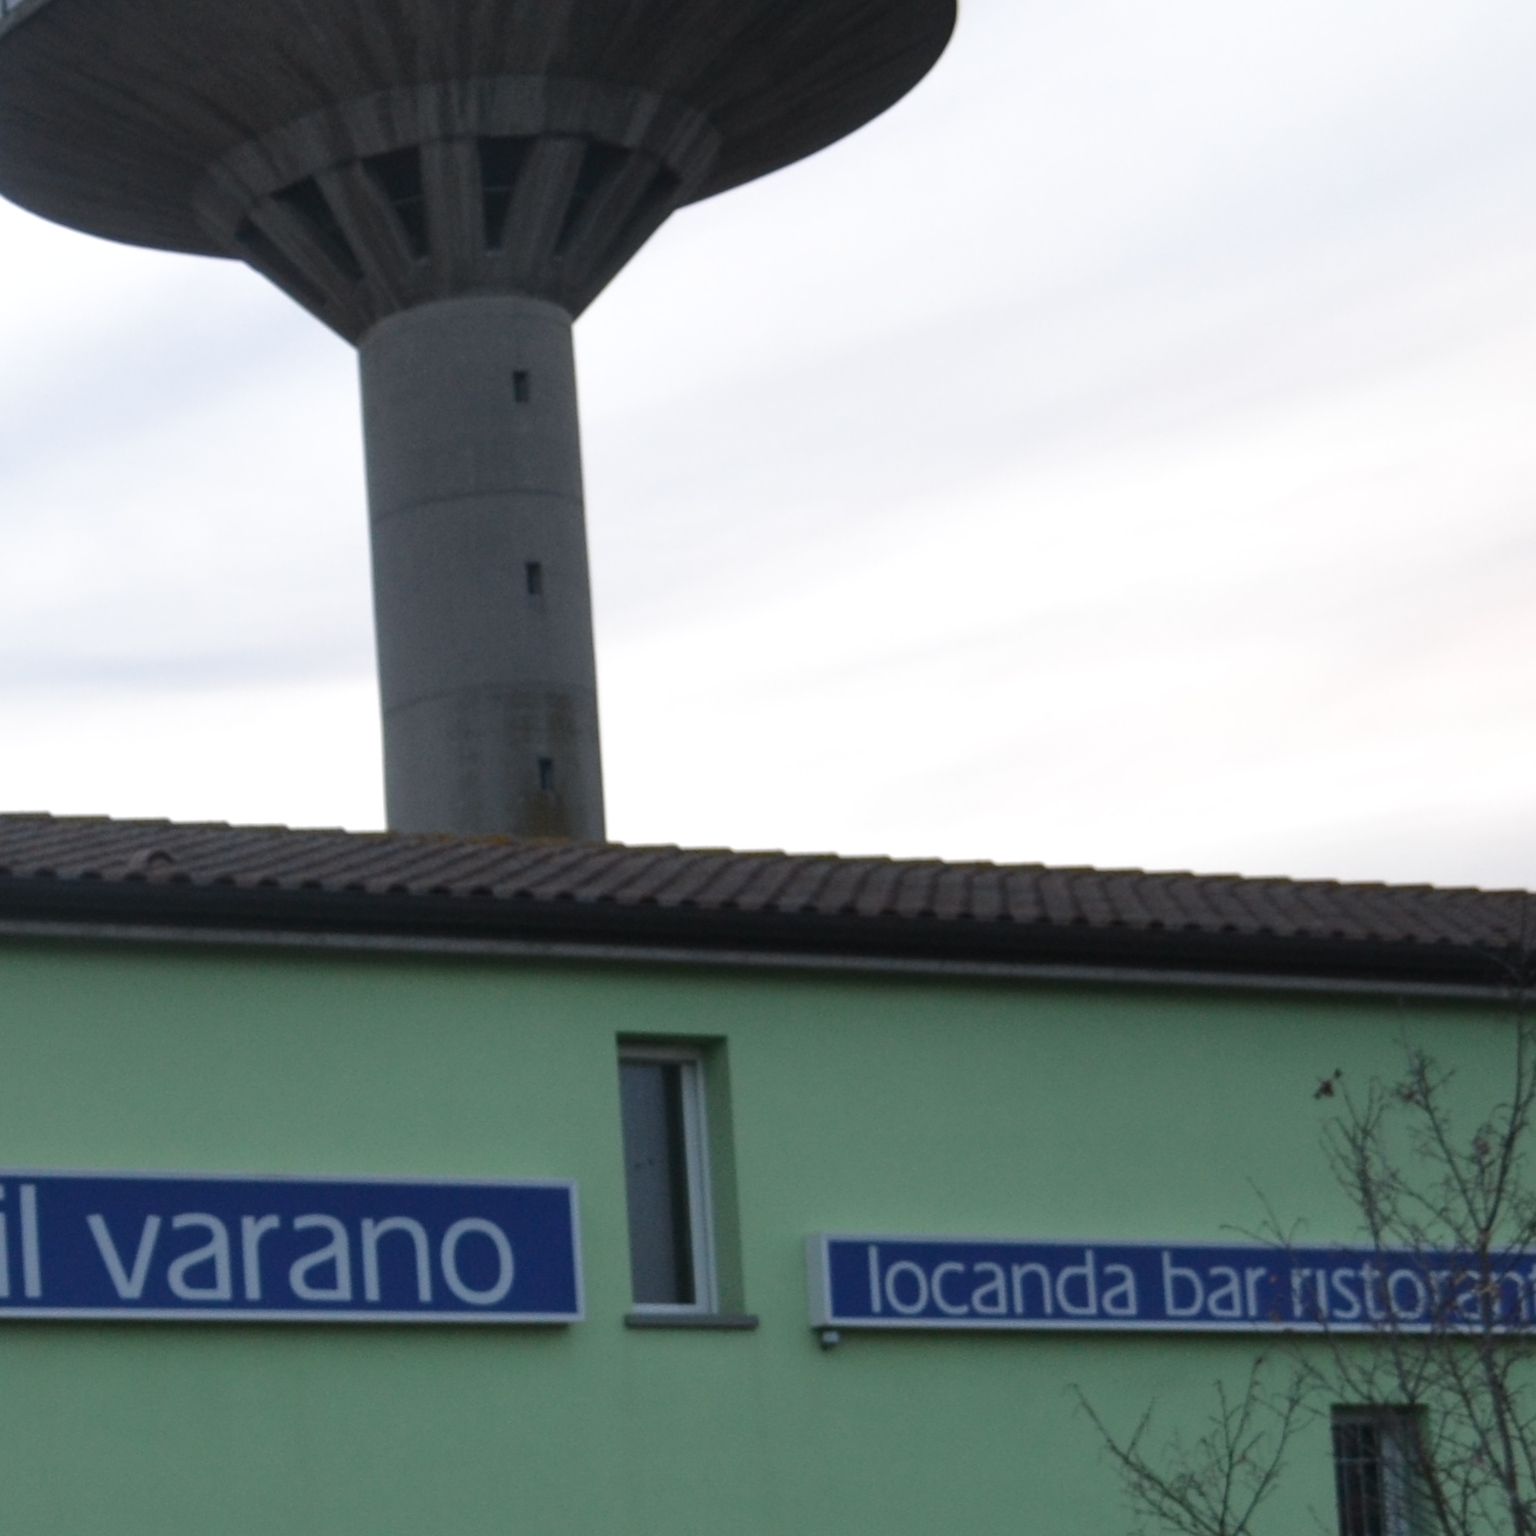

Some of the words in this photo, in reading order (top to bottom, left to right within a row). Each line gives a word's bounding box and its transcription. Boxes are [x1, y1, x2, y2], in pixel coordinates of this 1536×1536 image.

[86, 1211, 516, 1306] varano
[867, 1243, 1138, 1317] locanda
[1162, 1250, 1267, 1318] bar
